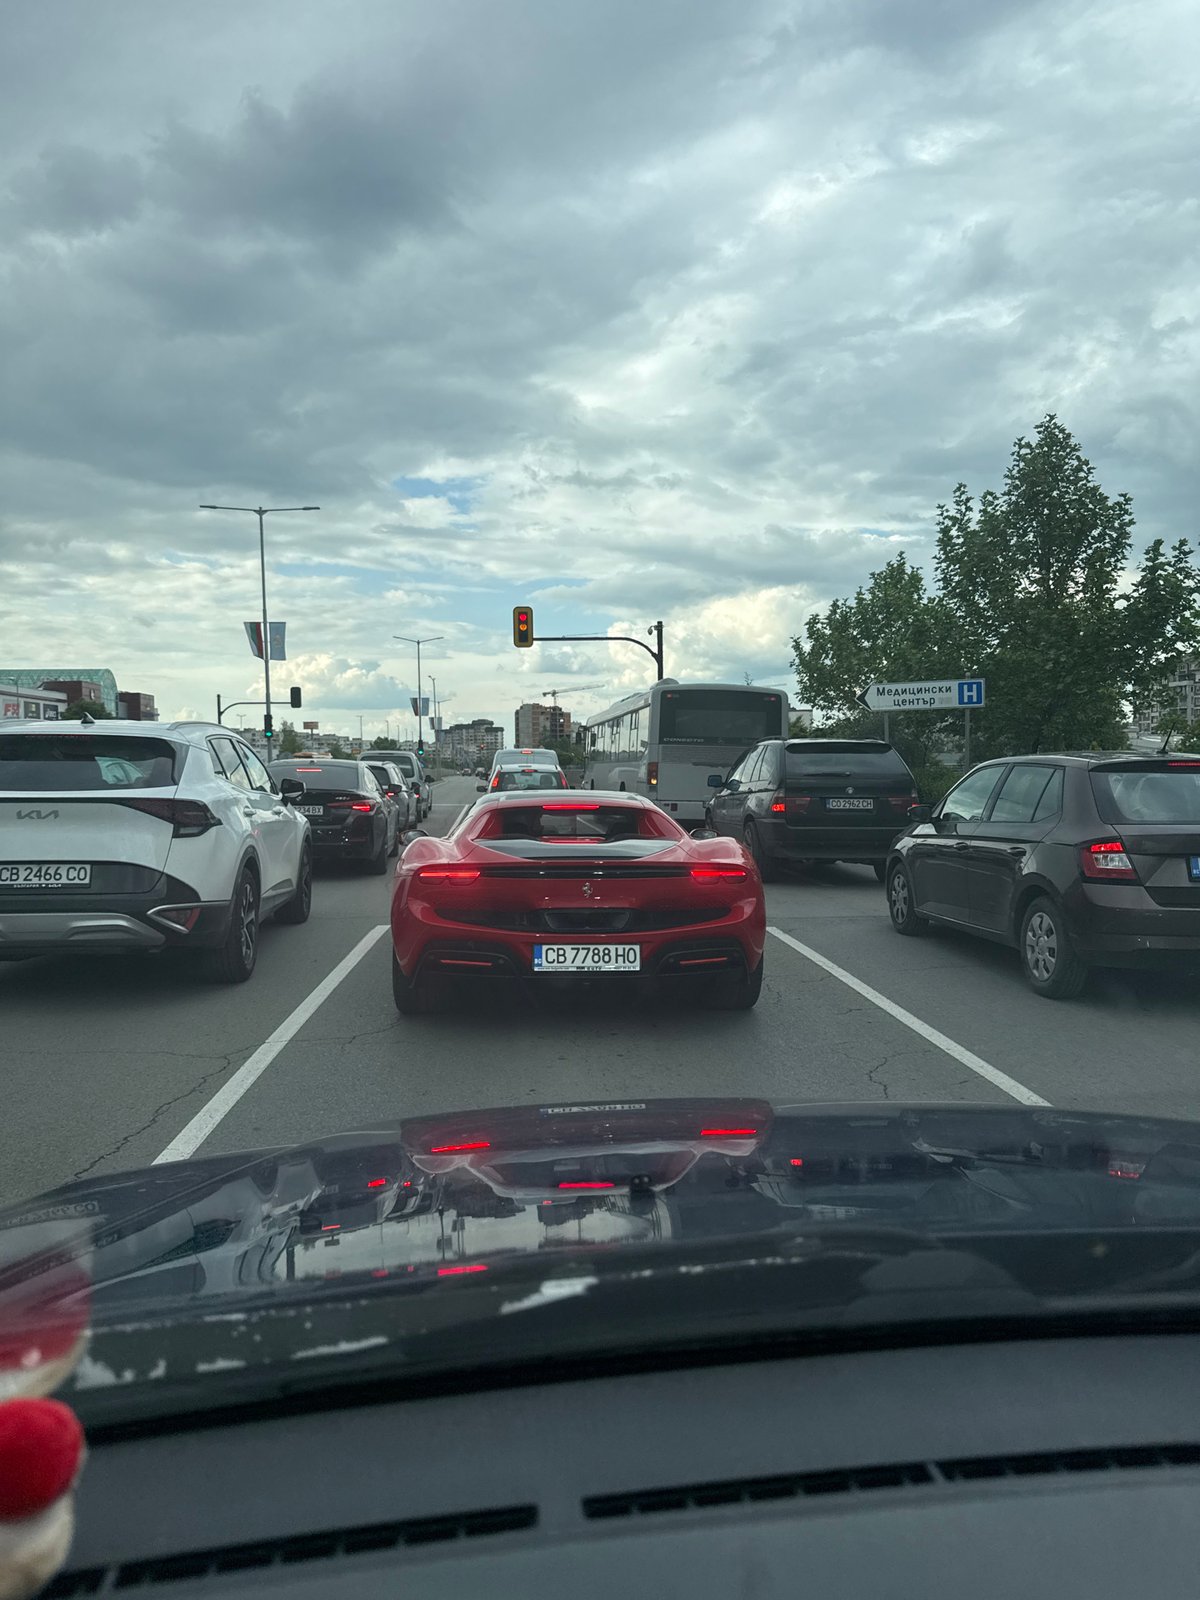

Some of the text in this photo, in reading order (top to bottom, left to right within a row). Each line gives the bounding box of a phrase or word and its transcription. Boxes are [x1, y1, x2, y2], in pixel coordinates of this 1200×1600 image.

[876, 685, 952, 697] Медицински
[893, 697, 936, 707] център
[16, 809, 59, 820] KIA
[23, 866, 63, 882] 2466
[545, 947, 567, 964] CB
[571, 947, 612, 964] 7788
